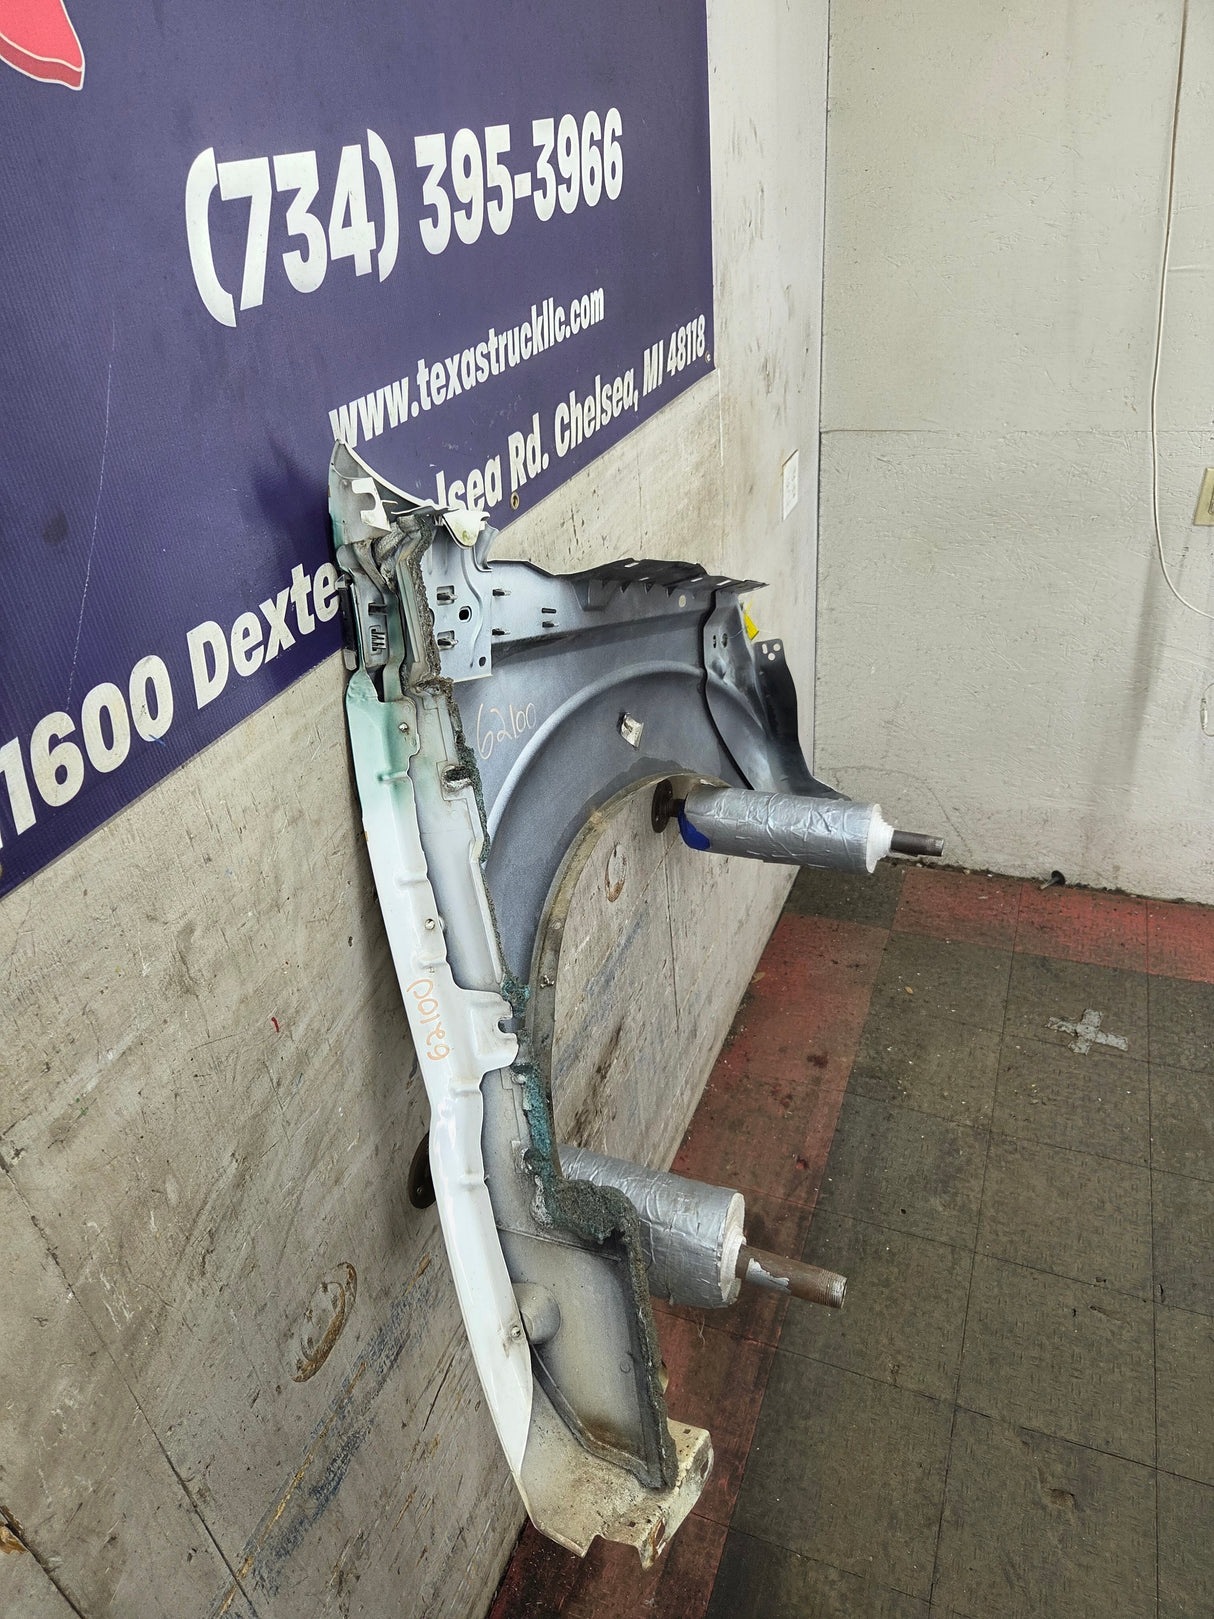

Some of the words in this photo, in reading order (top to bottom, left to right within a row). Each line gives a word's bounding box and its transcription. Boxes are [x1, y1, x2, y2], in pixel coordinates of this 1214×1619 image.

[185, 128, 400, 327] (734)
[414, 108, 623, 255] 395-3966
[328, 287, 605, 450] www.texastruckllc.com
[0, 654, 174, 848] 1600
[186, 562, 340, 709] Dexte
[436, 454, 503, 513] lsea
[508, 412, 549, 492] Rd.
[554, 374, 639, 458] Chelsea,
[643, 339, 664, 397] MI
[666, 314, 706, 377] 48118
[476, 702, 537, 759] 62100
[406, 978, 450, 1061] 62100
